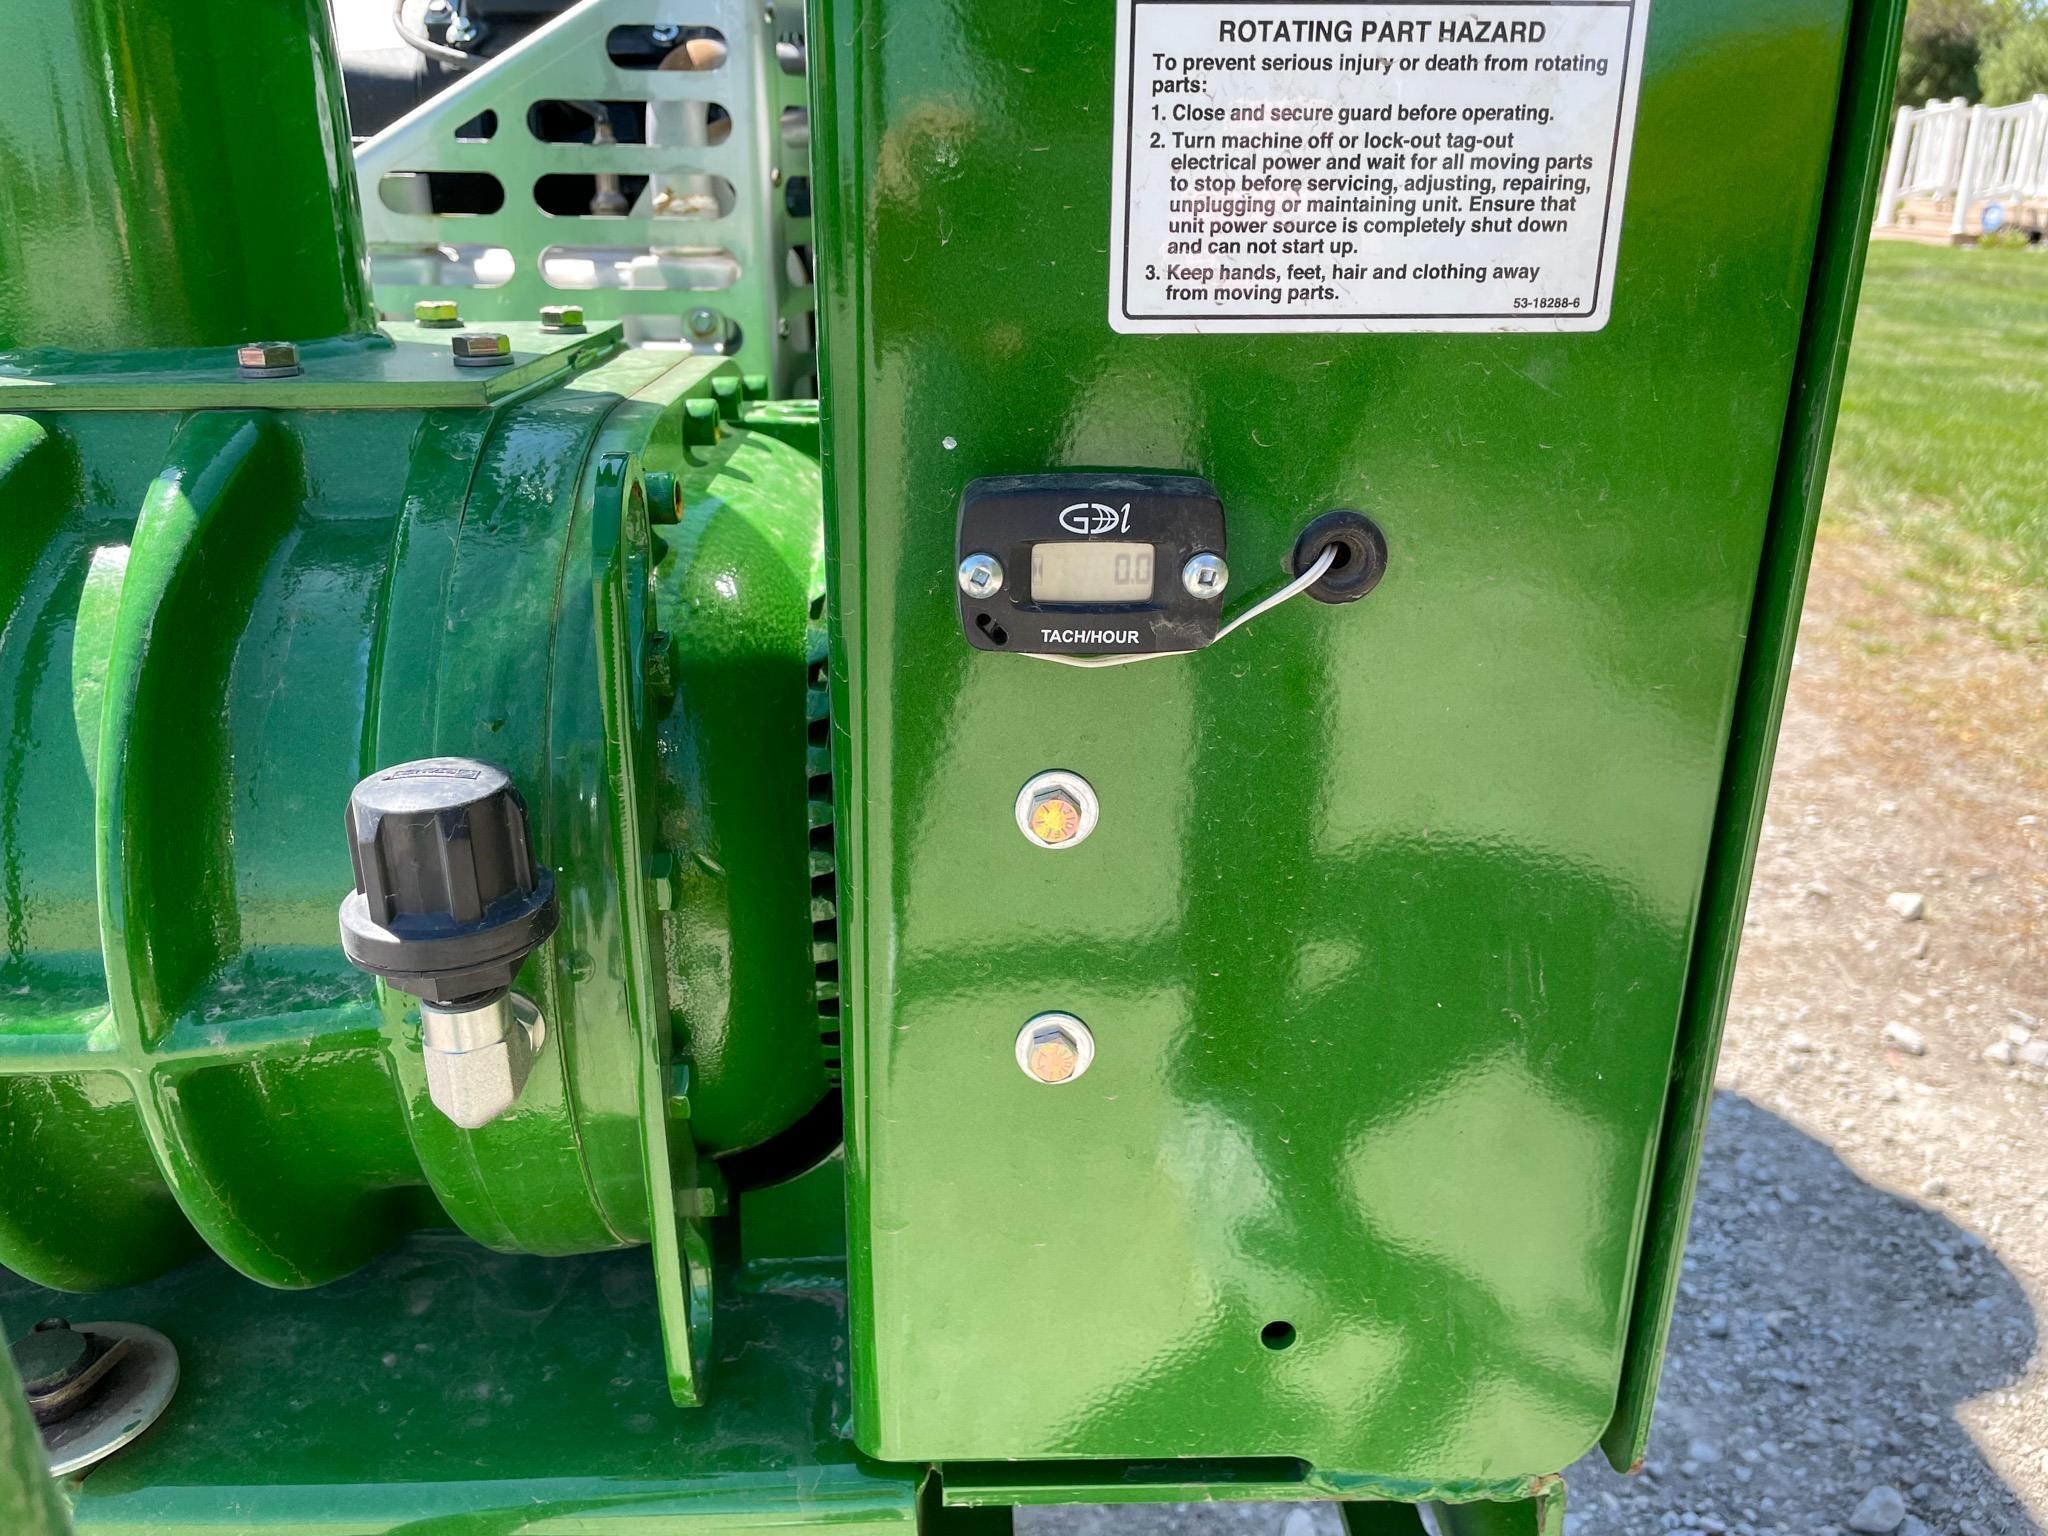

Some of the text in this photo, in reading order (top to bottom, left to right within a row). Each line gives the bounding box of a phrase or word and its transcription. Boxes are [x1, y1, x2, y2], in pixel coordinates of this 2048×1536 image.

[1218, 19, 1547, 44] ROTATING PART HAZARD
[1151, 52, 1609, 77] To prevent serious injury or death from rotating
[1151, 75, 1208, 95] parts:
[1151, 103, 1555, 126] 1. Close and secure guard before operating.
[1149, 130, 1515, 152] 2. Turn machine off or lock-out tag-out
[1170, 152, 1593, 173] electrical power and wait for all moving parts
[1169, 173, 1591, 196] to stop before servicing, adjusting, repairing,
[1169, 194, 1577, 217] unplugging or maintaining unit. Ensure that
[1168, 215, 1568, 237] unit power source is completely shut down
[1167, 237, 1359, 258] and can not start up.
[1144, 262, 1541, 284] 3. Keep hands, feet, hair and clothing away
[1164, 283, 1340, 304] from moving parts.
[1512, 296, 1581, 309] 53-18288-6
[1040, 629, 1140, 645] TACH/HOUR
